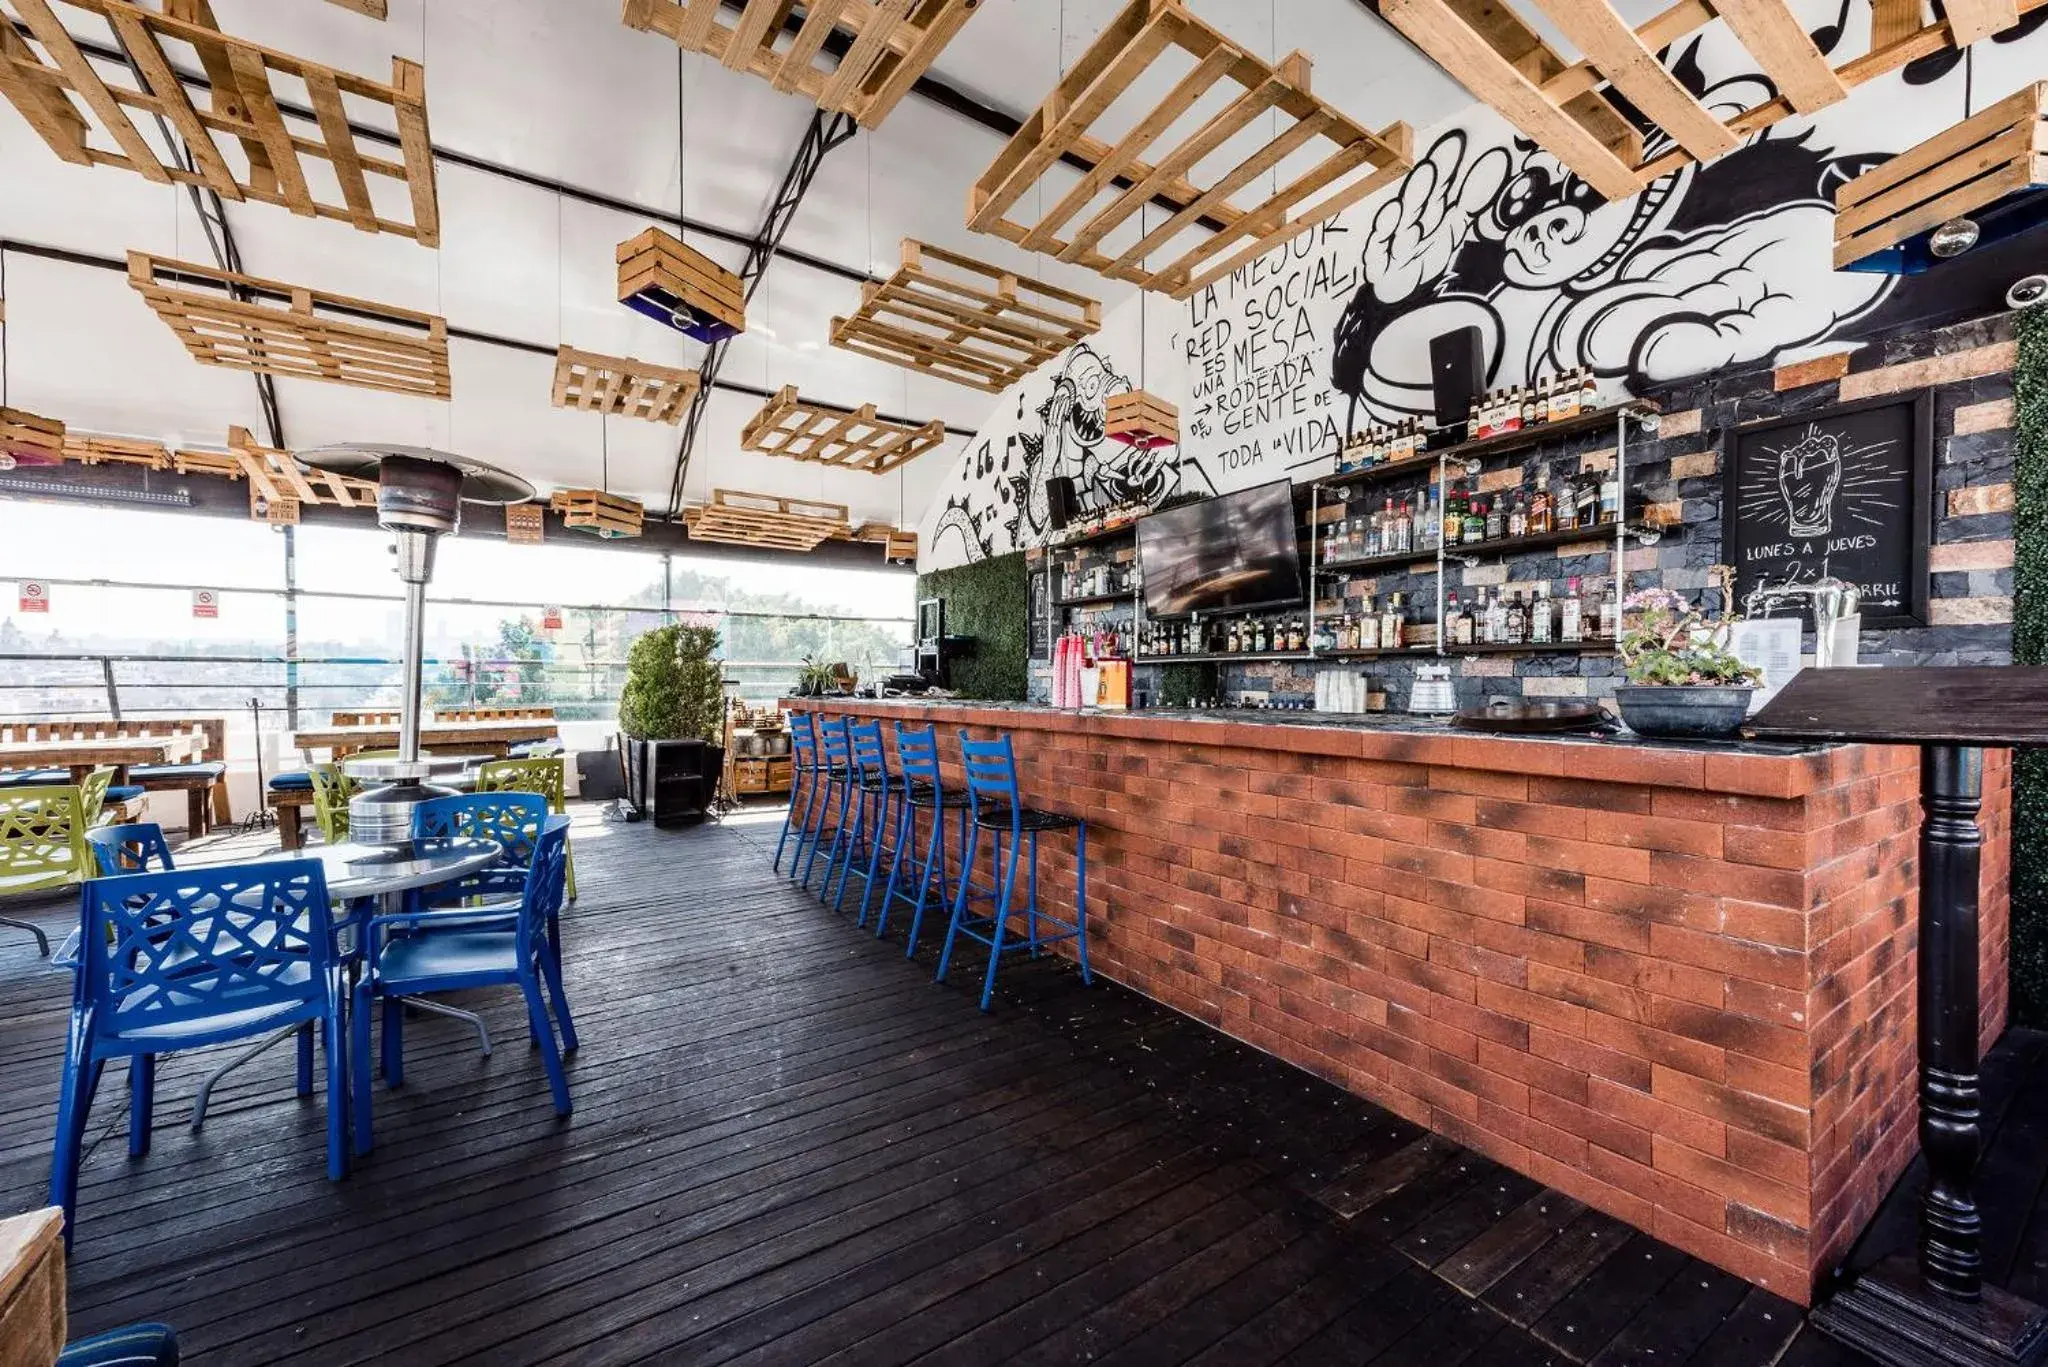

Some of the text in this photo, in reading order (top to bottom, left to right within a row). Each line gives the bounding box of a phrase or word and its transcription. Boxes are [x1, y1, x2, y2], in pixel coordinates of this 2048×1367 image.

[1191, 210, 1348, 328] LA MEJOR
[1185, 251, 1349, 365] RED SOCIAL
[1202, 352, 1226, 378] ES
[1233, 305, 1316, 384] MESA
[1193, 373, 1225, 399] UNA
[1216, 355, 1316, 416] RODEADA
[1224, 383, 1332, 435] GENTE DE
[1190, 417, 1212, 439] DE TU
[1218, 413, 1339, 474] TODA LA VIDA
[1747, 534, 1877, 561] LUNES A JUEVES
